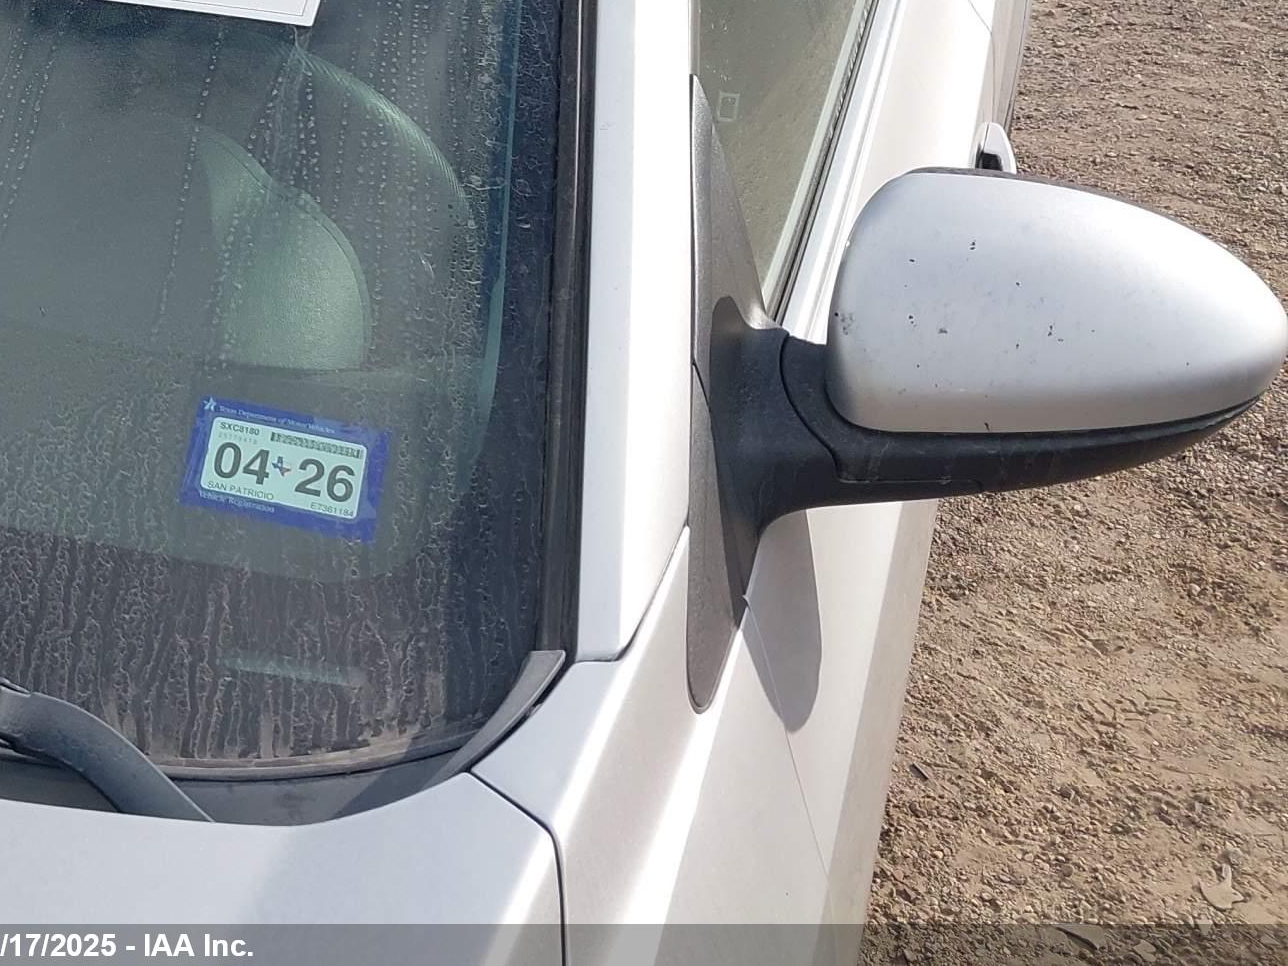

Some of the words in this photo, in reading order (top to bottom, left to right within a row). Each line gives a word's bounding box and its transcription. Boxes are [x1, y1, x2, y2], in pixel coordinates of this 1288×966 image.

[207, 481, 227, 491] SAN
[229, 484, 274, 501] PATRICIO
[214, 442, 270, 485] 04
[294, 458, 355, 503] 26
